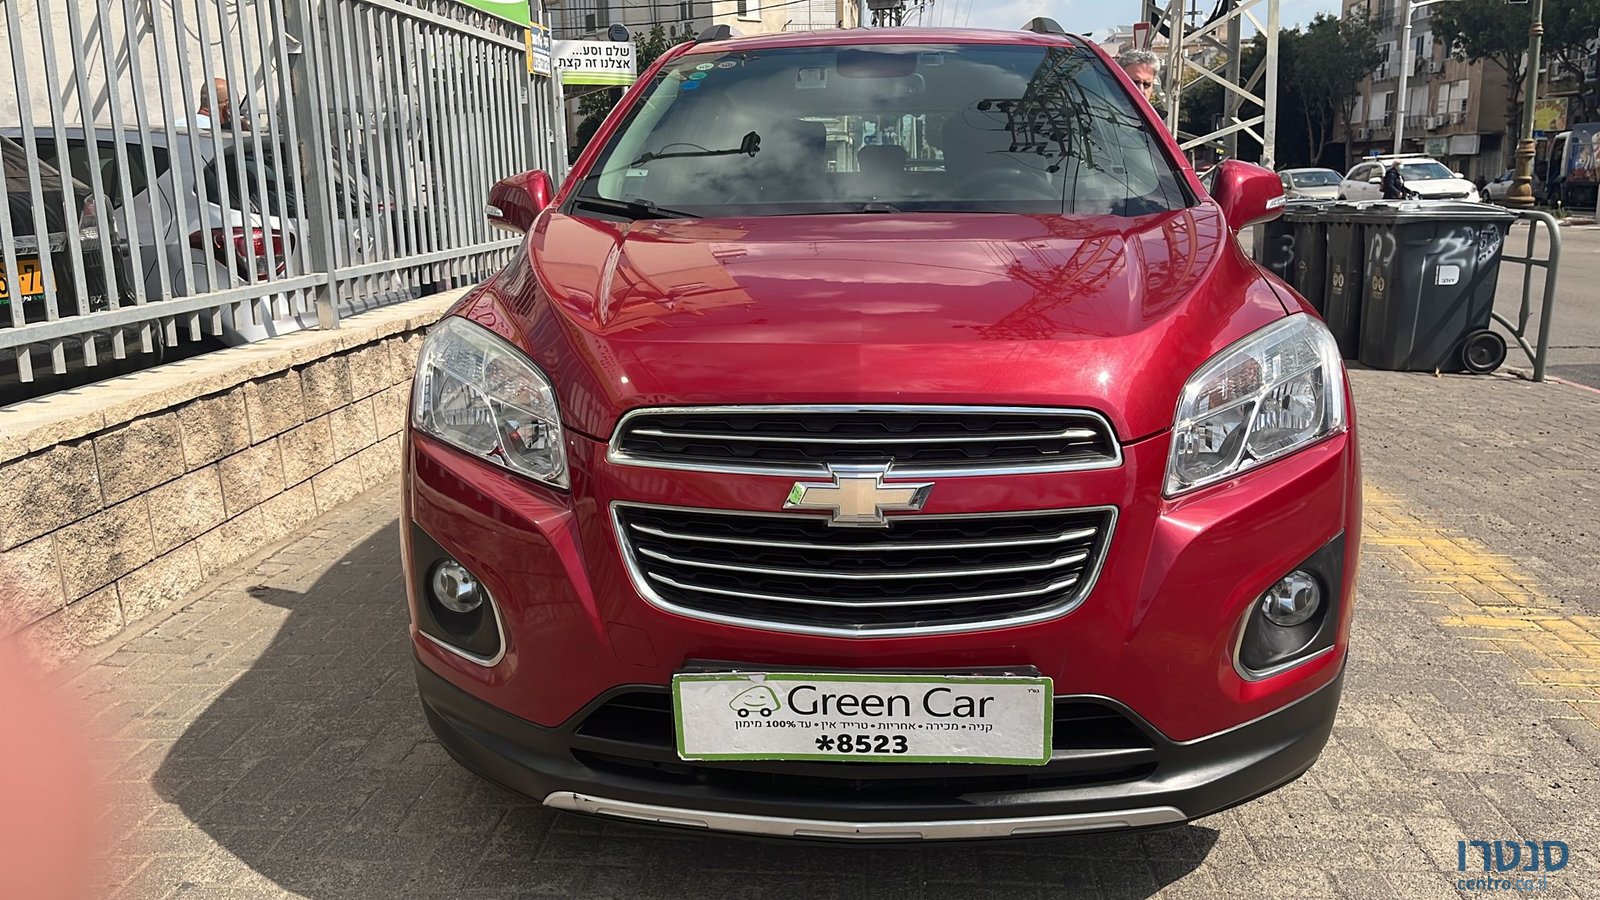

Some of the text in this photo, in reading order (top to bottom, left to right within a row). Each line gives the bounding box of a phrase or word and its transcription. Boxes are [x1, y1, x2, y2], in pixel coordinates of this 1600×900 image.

[606, 45, 629, 57] שלם
[558, 57, 581, 70] קצת
[585, 58, 597, 68] זה
[601, 57, 630, 69] אצלנו
[787, 685, 995, 718] Green Car
[735, 720, 993, 733] קניה מכירה אחריות טרייד אין עד 100% מימון
